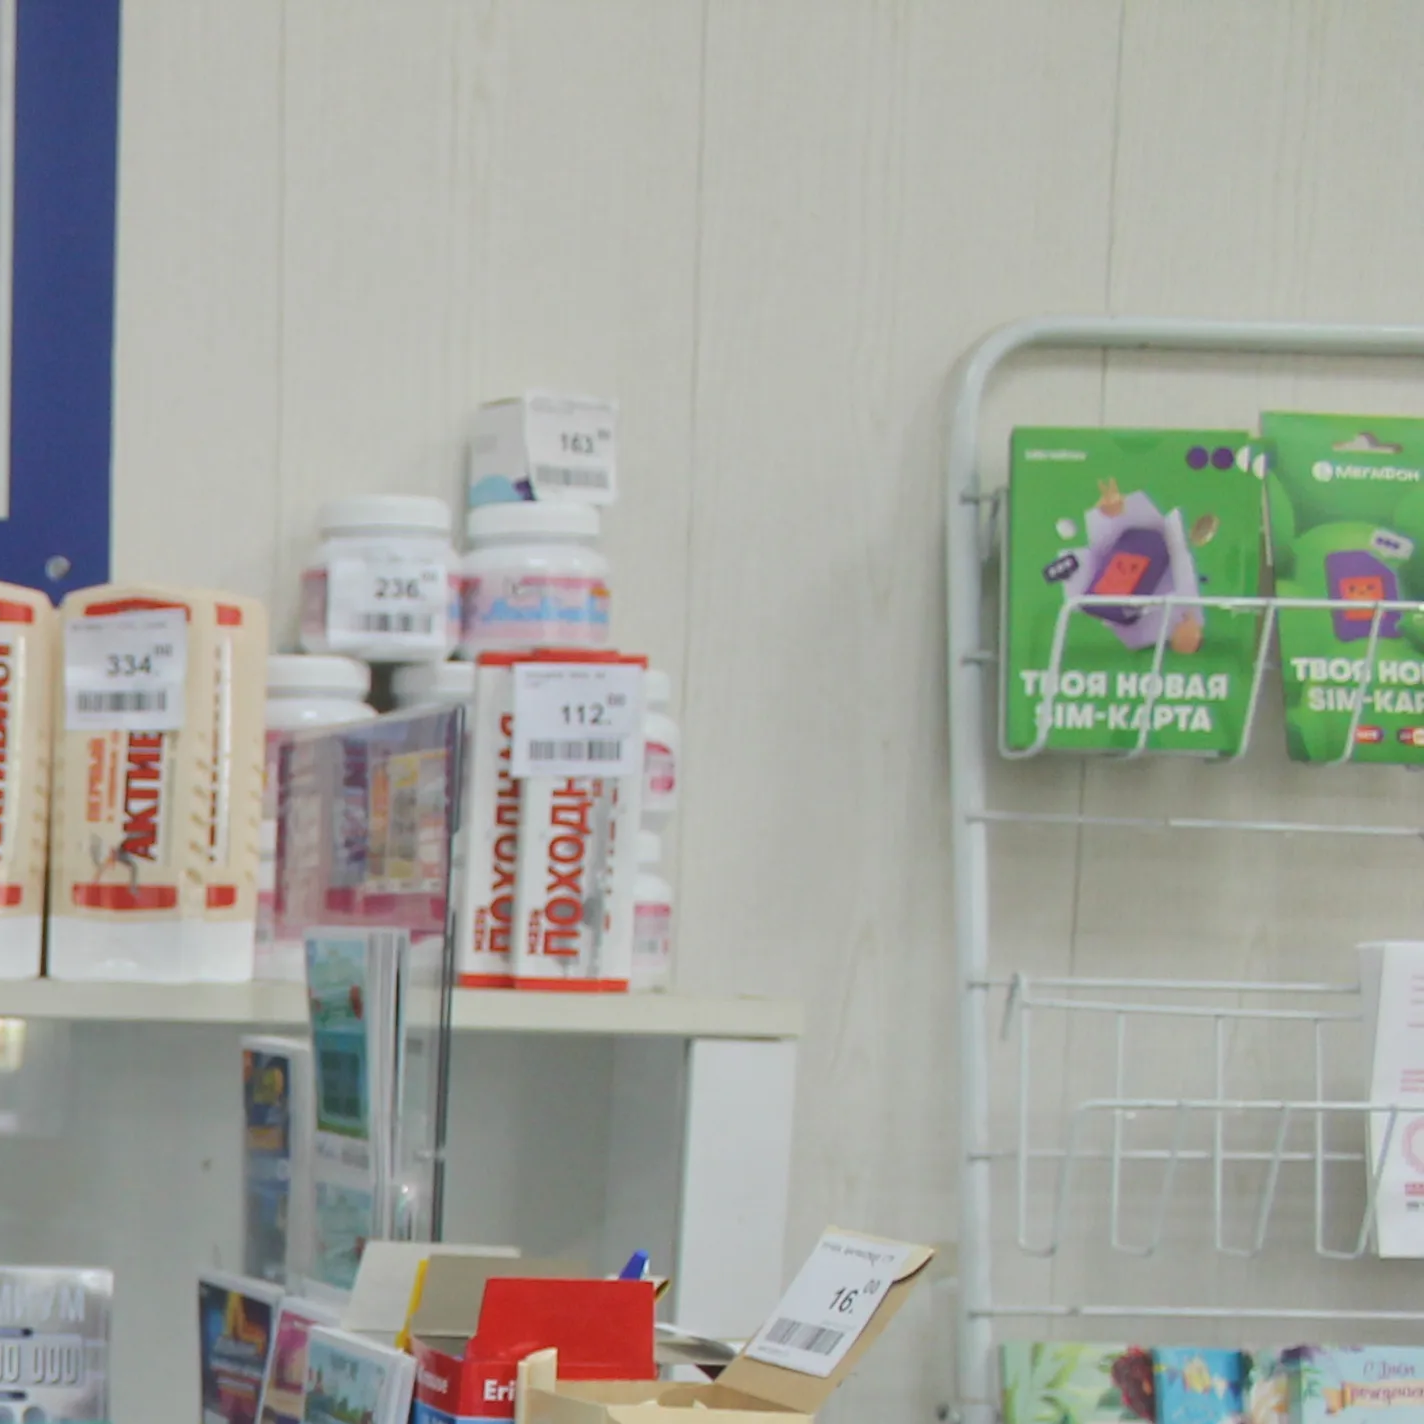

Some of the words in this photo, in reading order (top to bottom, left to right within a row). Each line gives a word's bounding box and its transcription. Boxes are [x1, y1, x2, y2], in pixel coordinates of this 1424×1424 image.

[1116, 672, 1229, 700] НОВАЯ
[120, 731, 163, 862] АКТИВ
[543, 777, 592, 958] ПОХОДН
[483, 1379, 516, 1402] Eri
